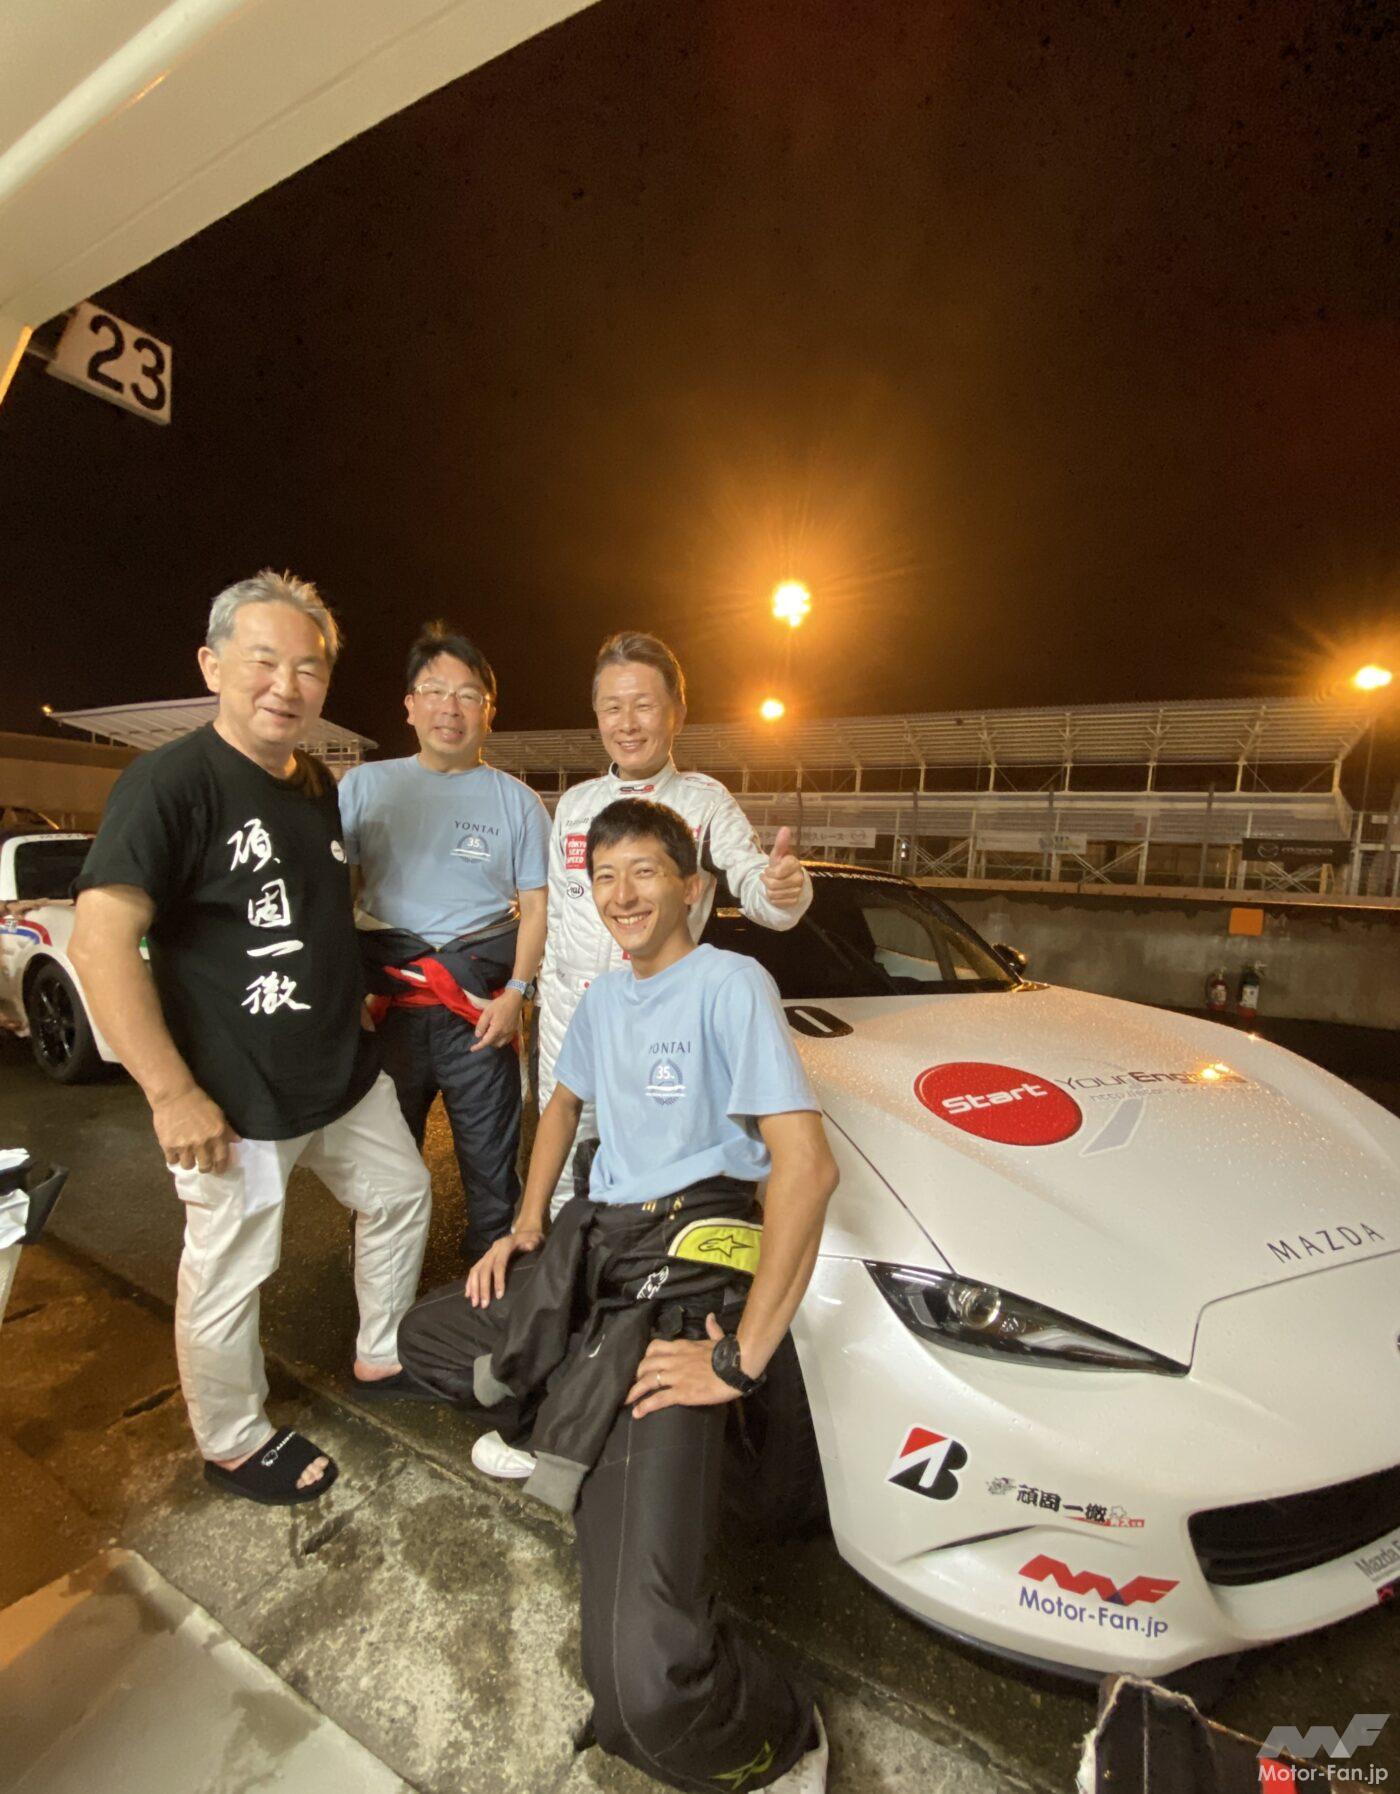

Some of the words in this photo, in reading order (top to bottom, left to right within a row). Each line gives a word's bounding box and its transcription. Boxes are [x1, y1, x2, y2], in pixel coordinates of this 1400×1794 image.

[87, 314, 166, 411] 23
[454, 820, 499, 836] YONTAI
[941, 1083, 1048, 1115] Start
[1266, 1222, 1386, 1264] MAZDA
[1019, 1586, 1168, 1637] Motor-Fan.jp
